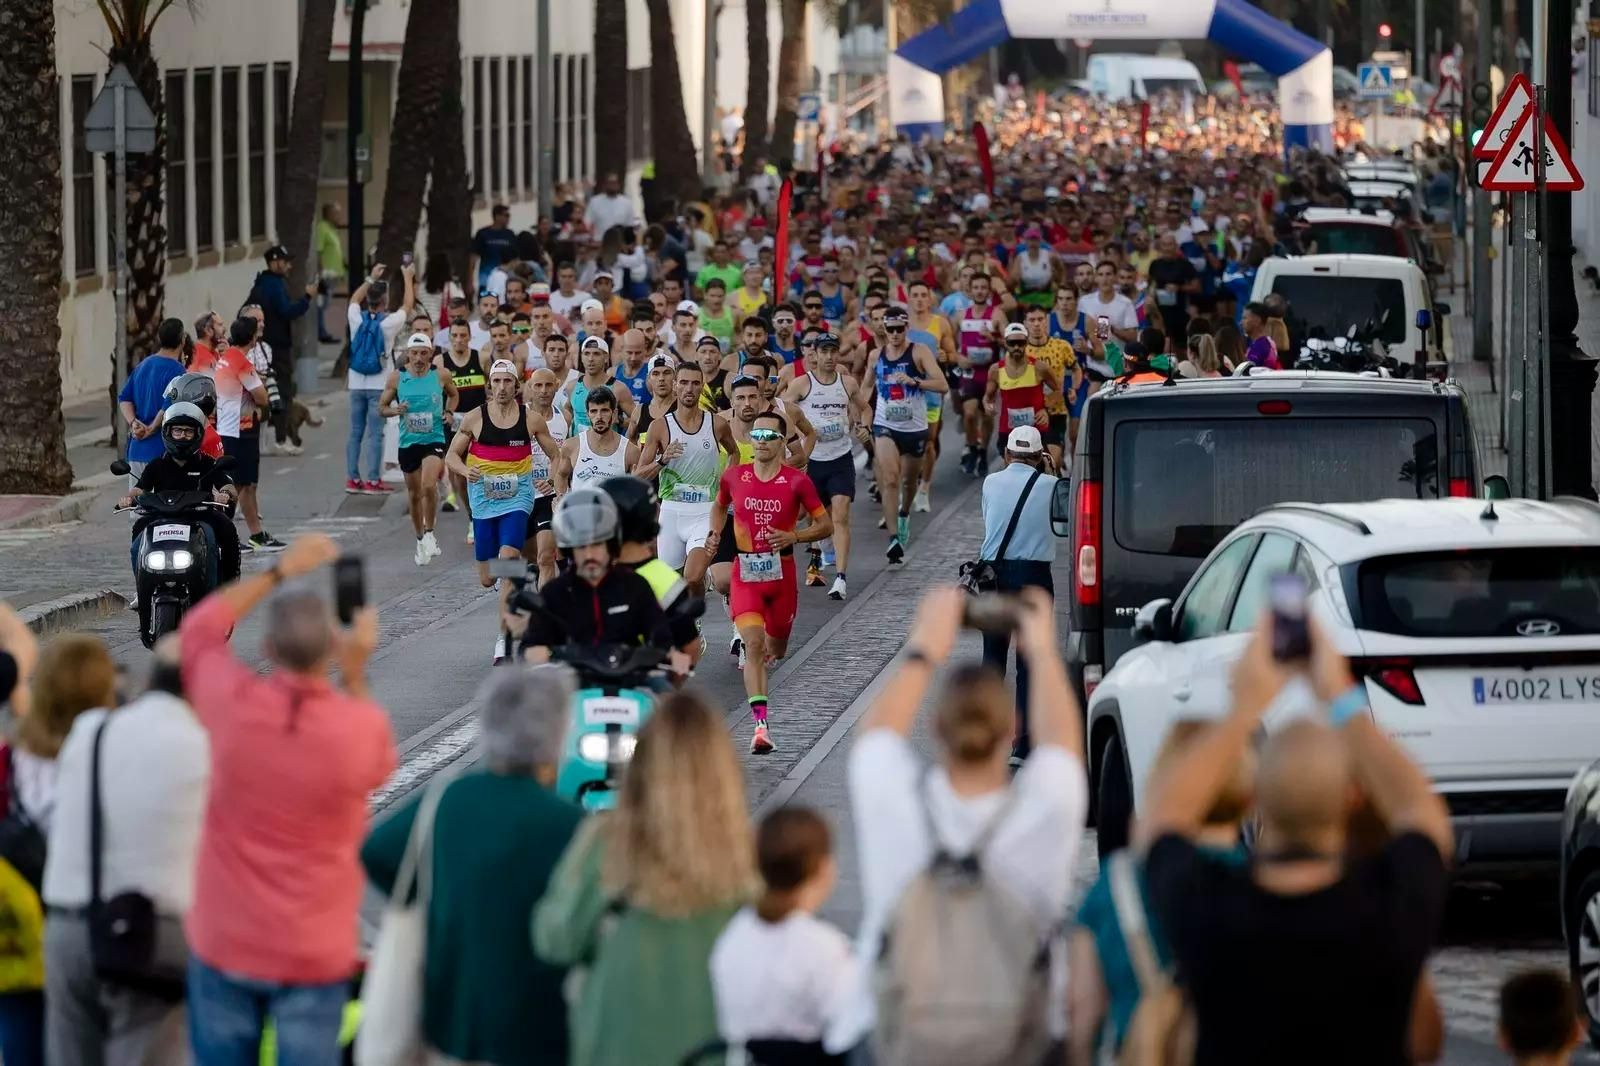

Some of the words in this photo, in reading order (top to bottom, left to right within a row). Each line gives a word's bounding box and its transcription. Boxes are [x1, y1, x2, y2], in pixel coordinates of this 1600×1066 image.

[492, 481, 512, 491] 1463
[682, 492, 702, 501] 1501
[744, 497, 781, 512] OROZCO
[754, 513, 773, 525] ESP
[749, 560, 772, 572] 1530
[1490, 679, 1551, 700] 4002
